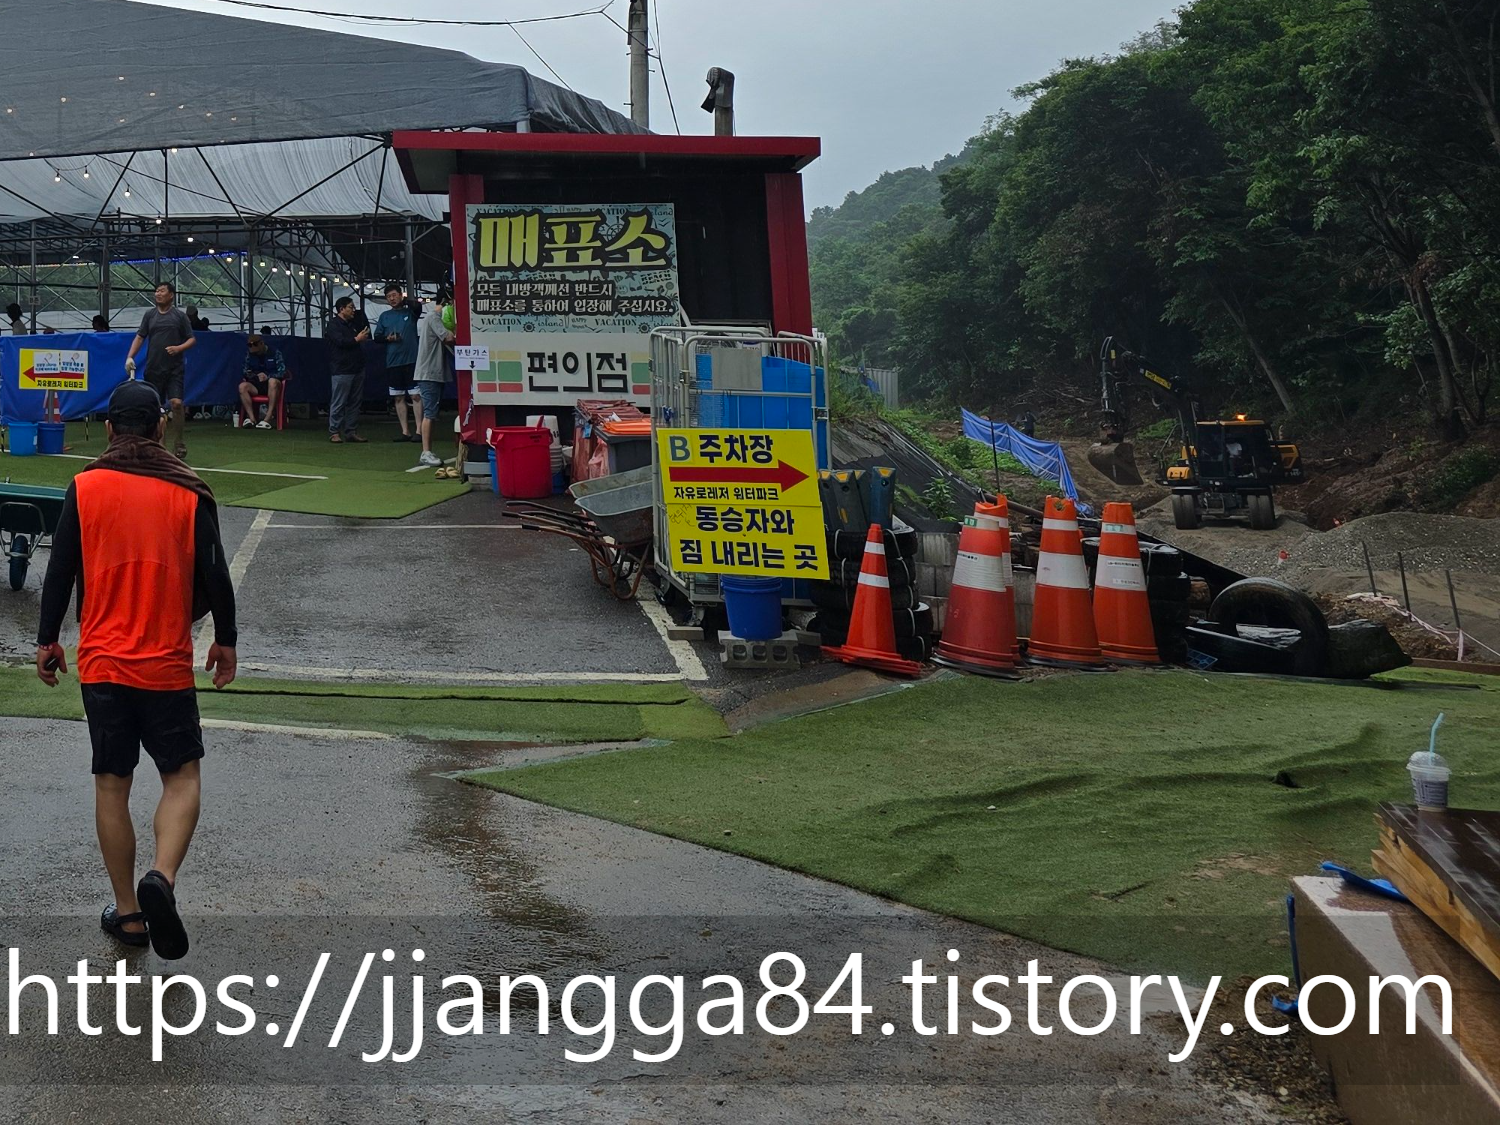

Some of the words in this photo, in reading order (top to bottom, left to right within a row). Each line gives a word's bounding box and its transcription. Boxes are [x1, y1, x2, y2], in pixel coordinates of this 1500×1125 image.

[478, 213, 667, 268] 매표소
[476, 283, 500, 296] 모든
[506, 283, 570, 296] 내방객께선
[574, 283, 613, 296] 반드시
[476, 299, 526, 312] 매표소를
[531, 299, 569, 312] 통하여
[574, 299, 612, 312] 입장해
[618, 299, 674, 313] 주십시요.
[481, 318, 522, 326] VACATION
[595, 318, 638, 326] VACATION
[527, 351, 629, 393] 편의점
[669, 435, 691, 462] B
[698, 434, 774, 464] 주차장
[673, 486, 730, 500] 자유로레저
[733, 487, 779, 501] 워터파크
[695, 506, 795, 536] 동승자와
[679, 539, 703, 565] 짐
[710, 540, 785, 569] 내리는
[793, 544, 819, 572] 곳
